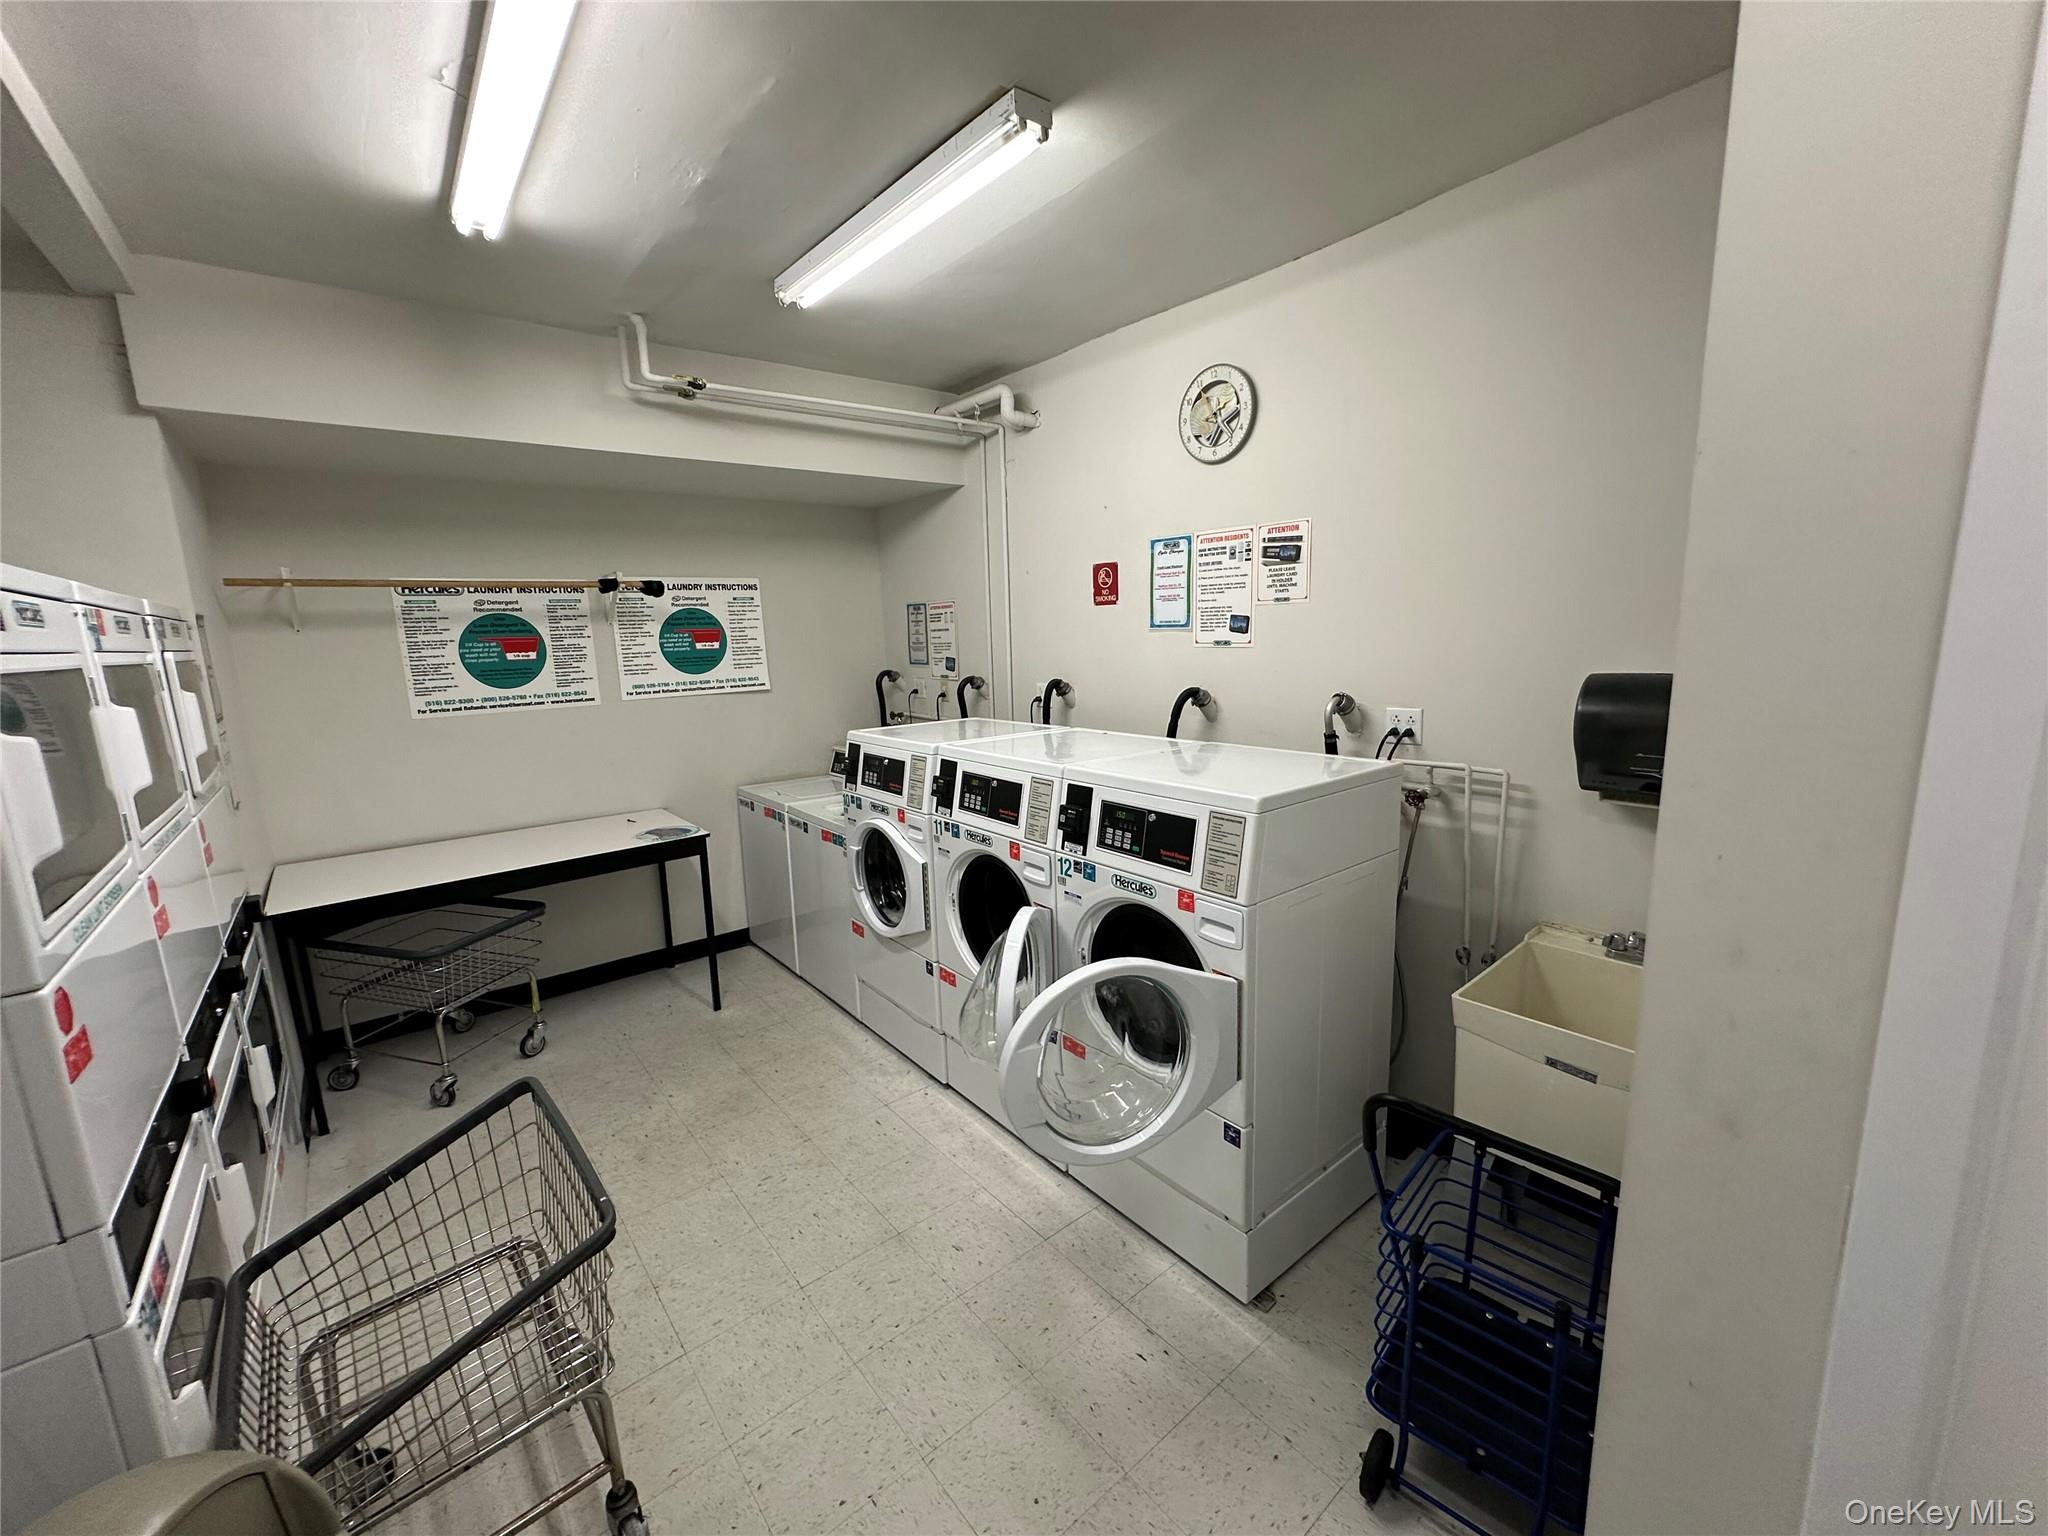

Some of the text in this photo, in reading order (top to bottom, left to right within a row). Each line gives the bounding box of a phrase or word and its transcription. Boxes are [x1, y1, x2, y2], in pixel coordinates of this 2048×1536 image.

[1267, 524, 1300, 535] ATTENTION
[1200, 533, 1249, 544] ATTENTION RESIDENTS
[467, 586, 513, 594] LAUNDRY
[516, 586, 585, 594] INSTRUCTIONS
[666, 583, 758, 591] LAUNDRY INSTRUCTIONS
[486, 599, 519, 607] Detergent
[424, 700, 443, 708] (516)
[480, 696, 498, 704] (800)
[842, 793, 850, 807] 10
[871, 802, 889, 814] Hercules
[934, 819, 943, 836] 11
[966, 830, 992, 846] Hercules
[1057, 856, 1073, 878] 12
[1114, 873, 1154, 897] Hercules
